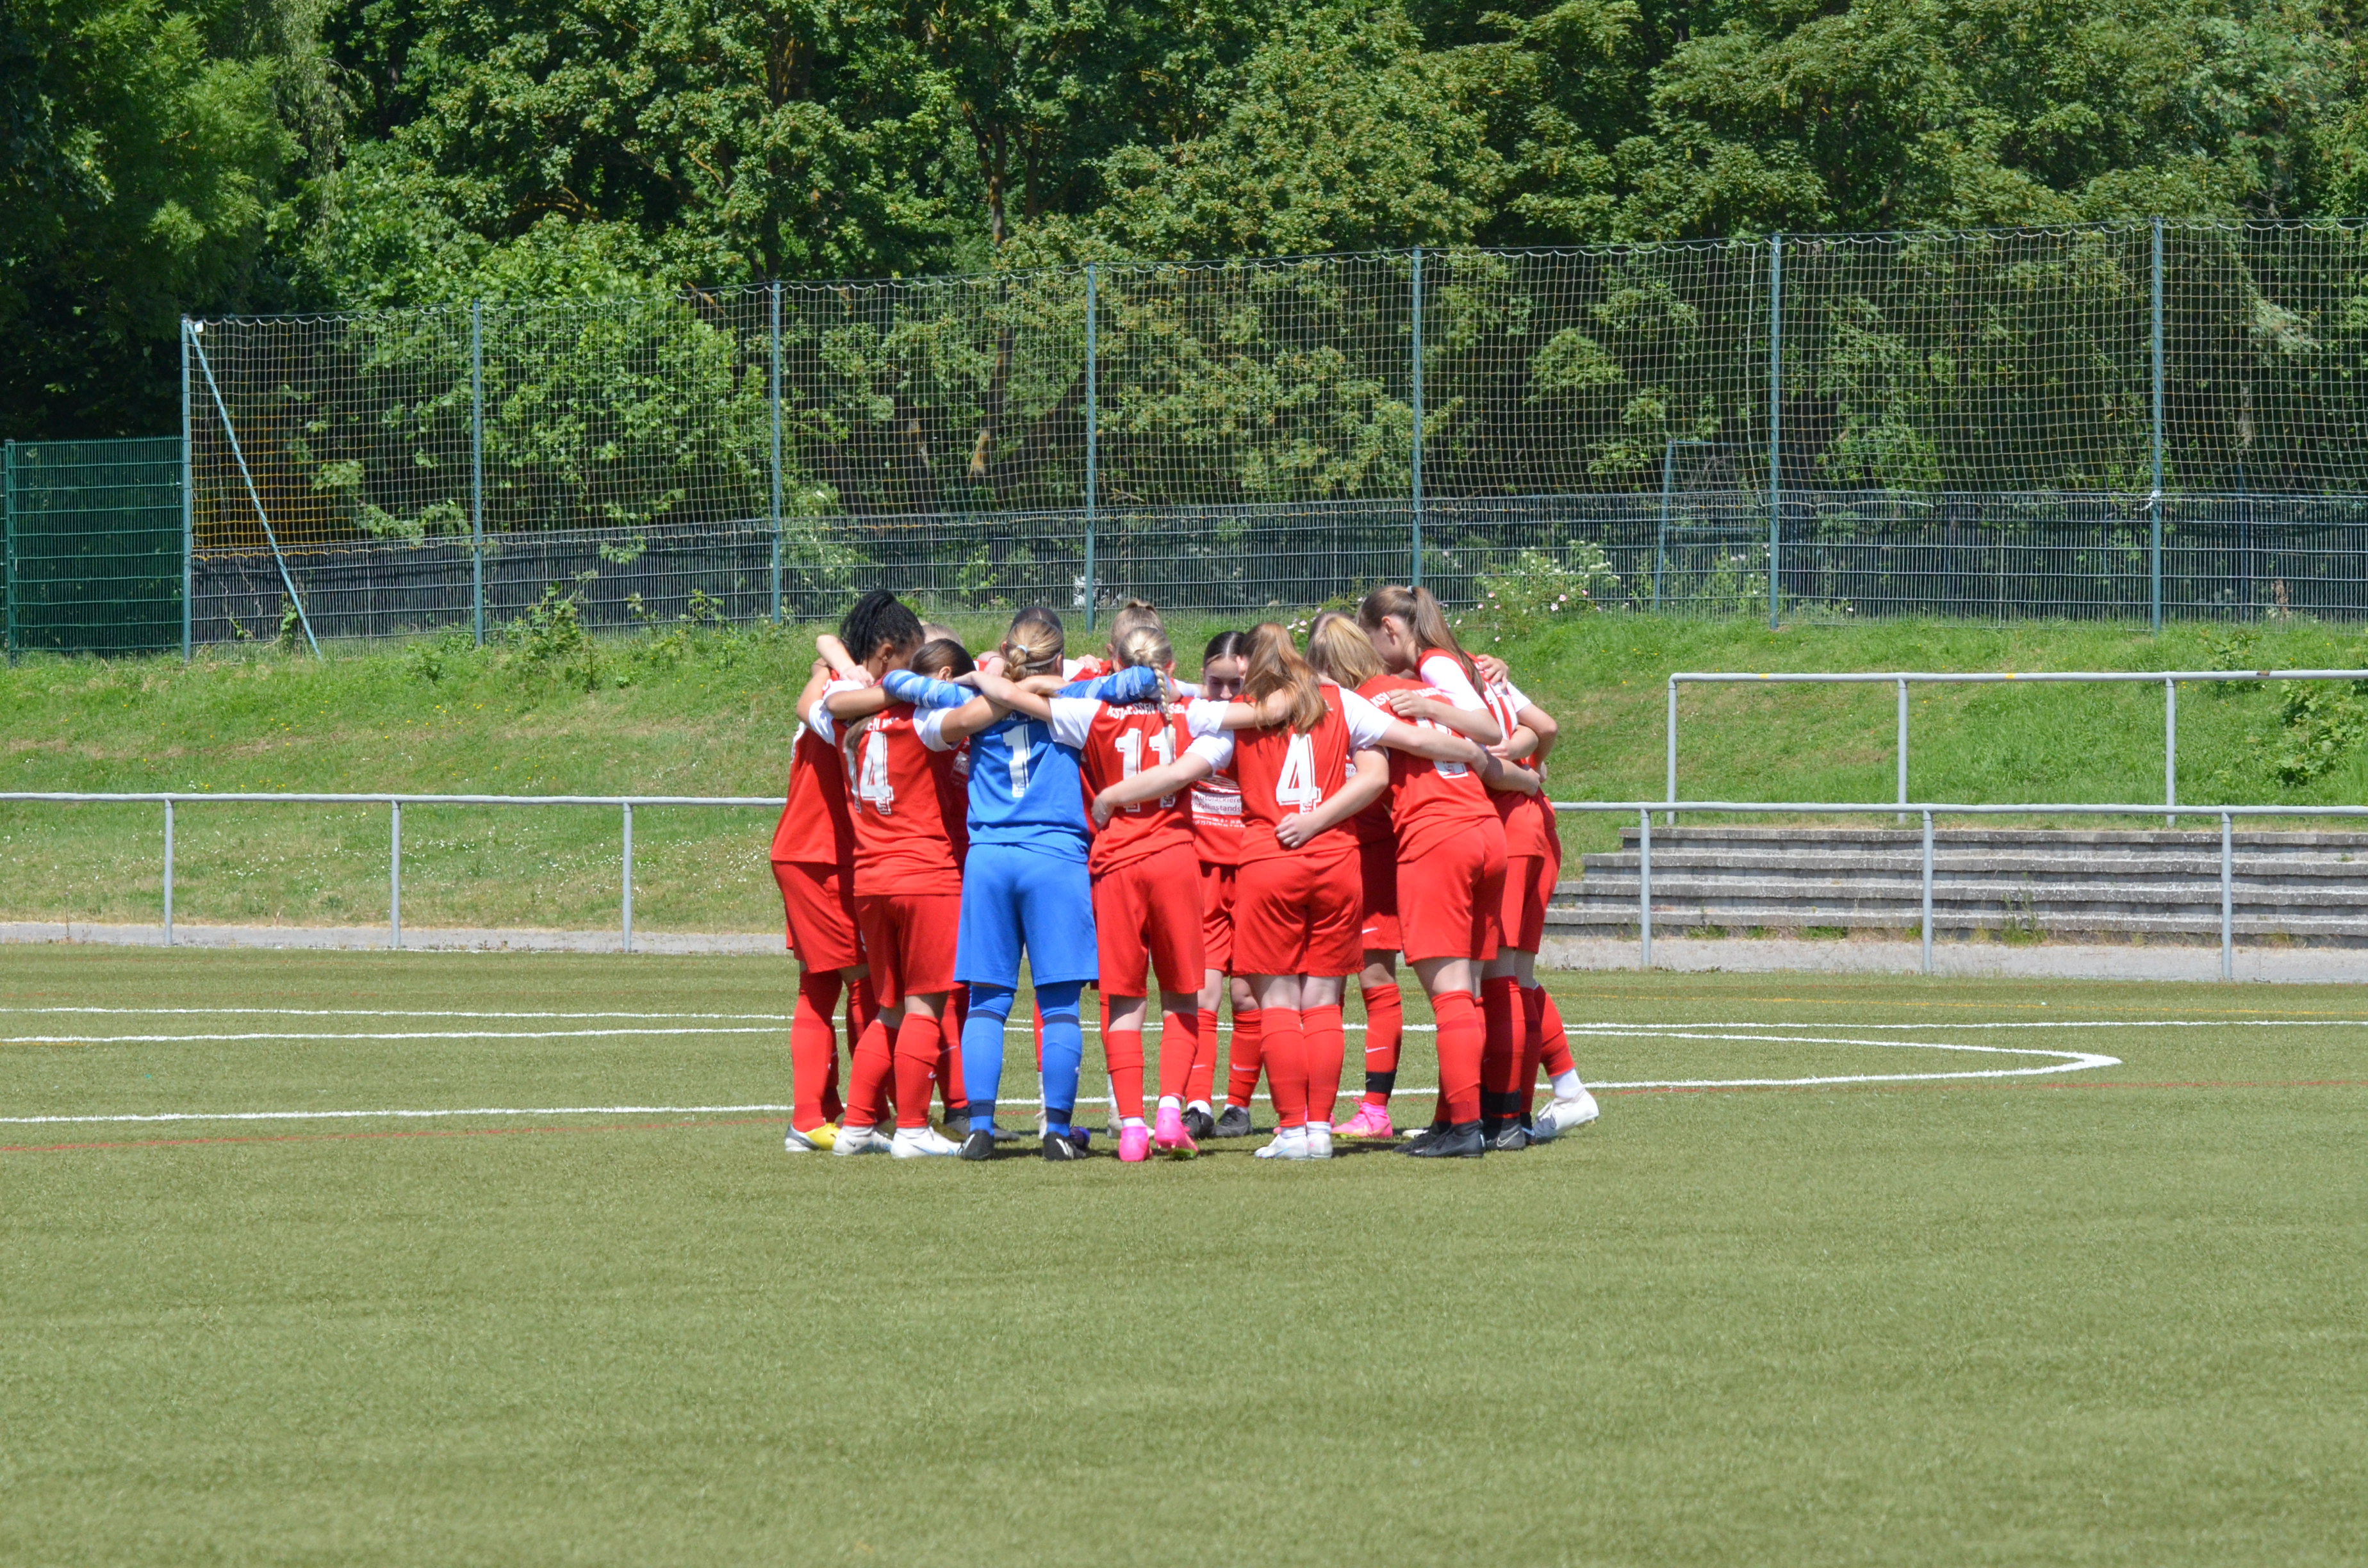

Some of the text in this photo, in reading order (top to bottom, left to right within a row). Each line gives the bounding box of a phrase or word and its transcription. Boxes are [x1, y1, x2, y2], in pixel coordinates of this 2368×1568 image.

[1106, 705, 1126, 721] KSV
[1369, 691, 1390, 708] KSV
[1003, 723, 1030, 798] 1
[1115, 727, 1176, 813] 11
[1276, 733, 1322, 815] 4
